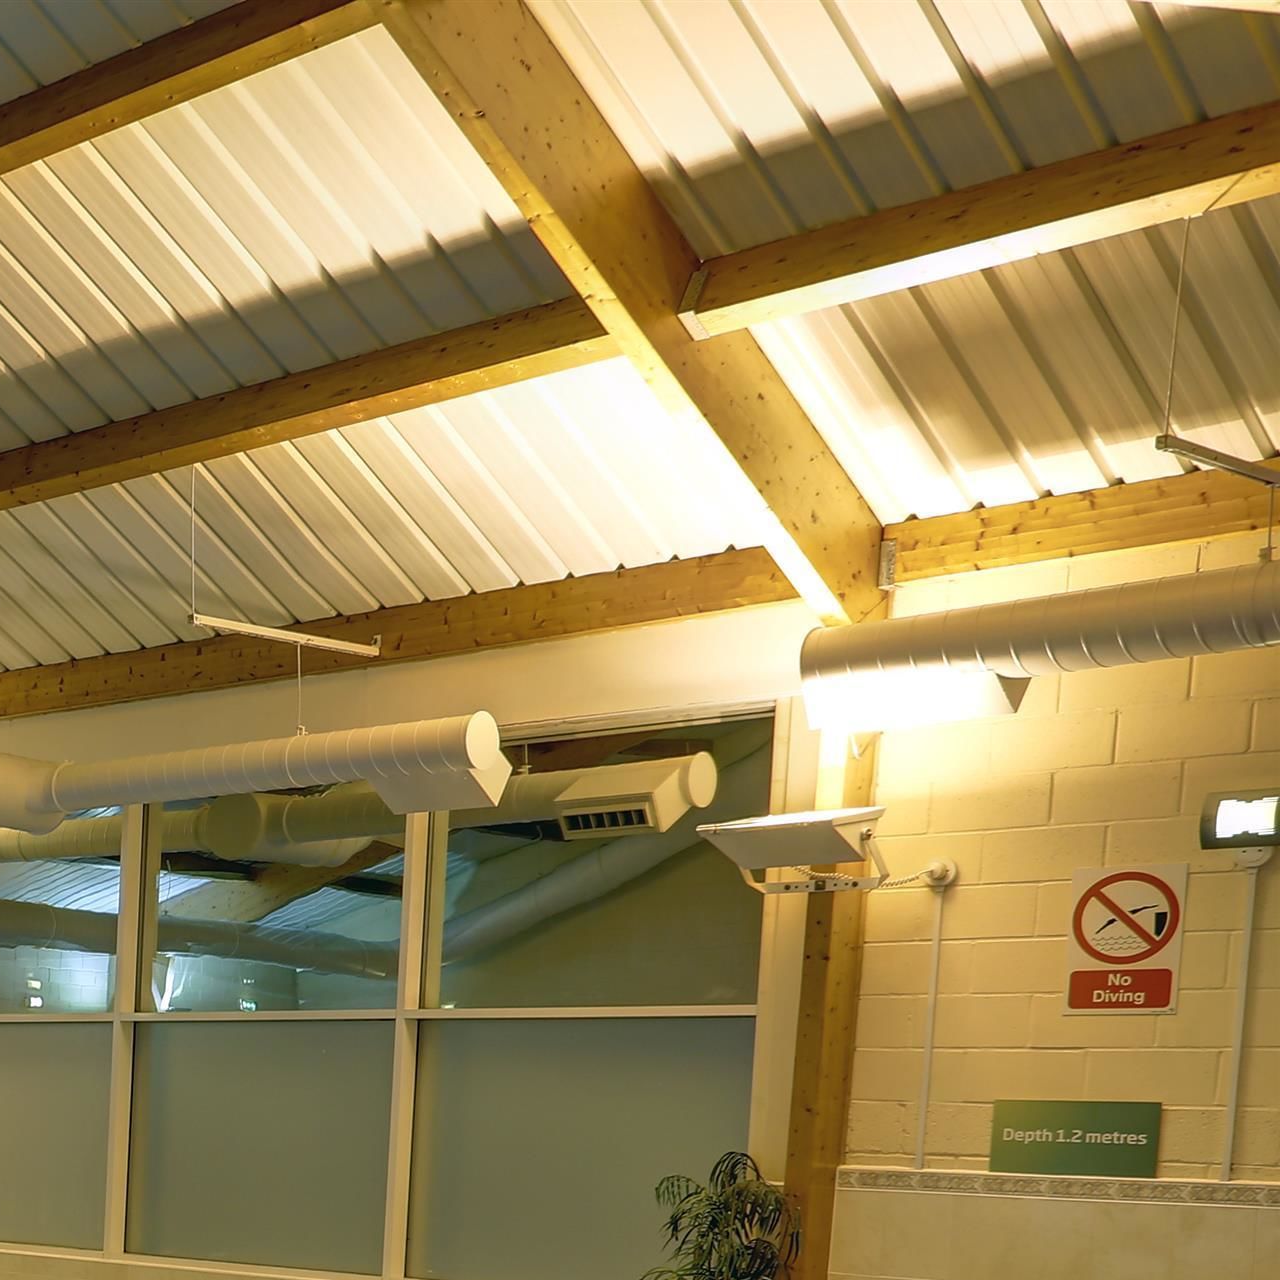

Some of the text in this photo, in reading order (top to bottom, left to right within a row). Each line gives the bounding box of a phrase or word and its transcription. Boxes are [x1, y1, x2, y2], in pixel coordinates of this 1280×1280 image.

[1107, 973, 1132, 986] No
[1092, 989, 1145, 1005] Diving
[1002, 1128, 1148, 1145] Depth 1.2 metres
